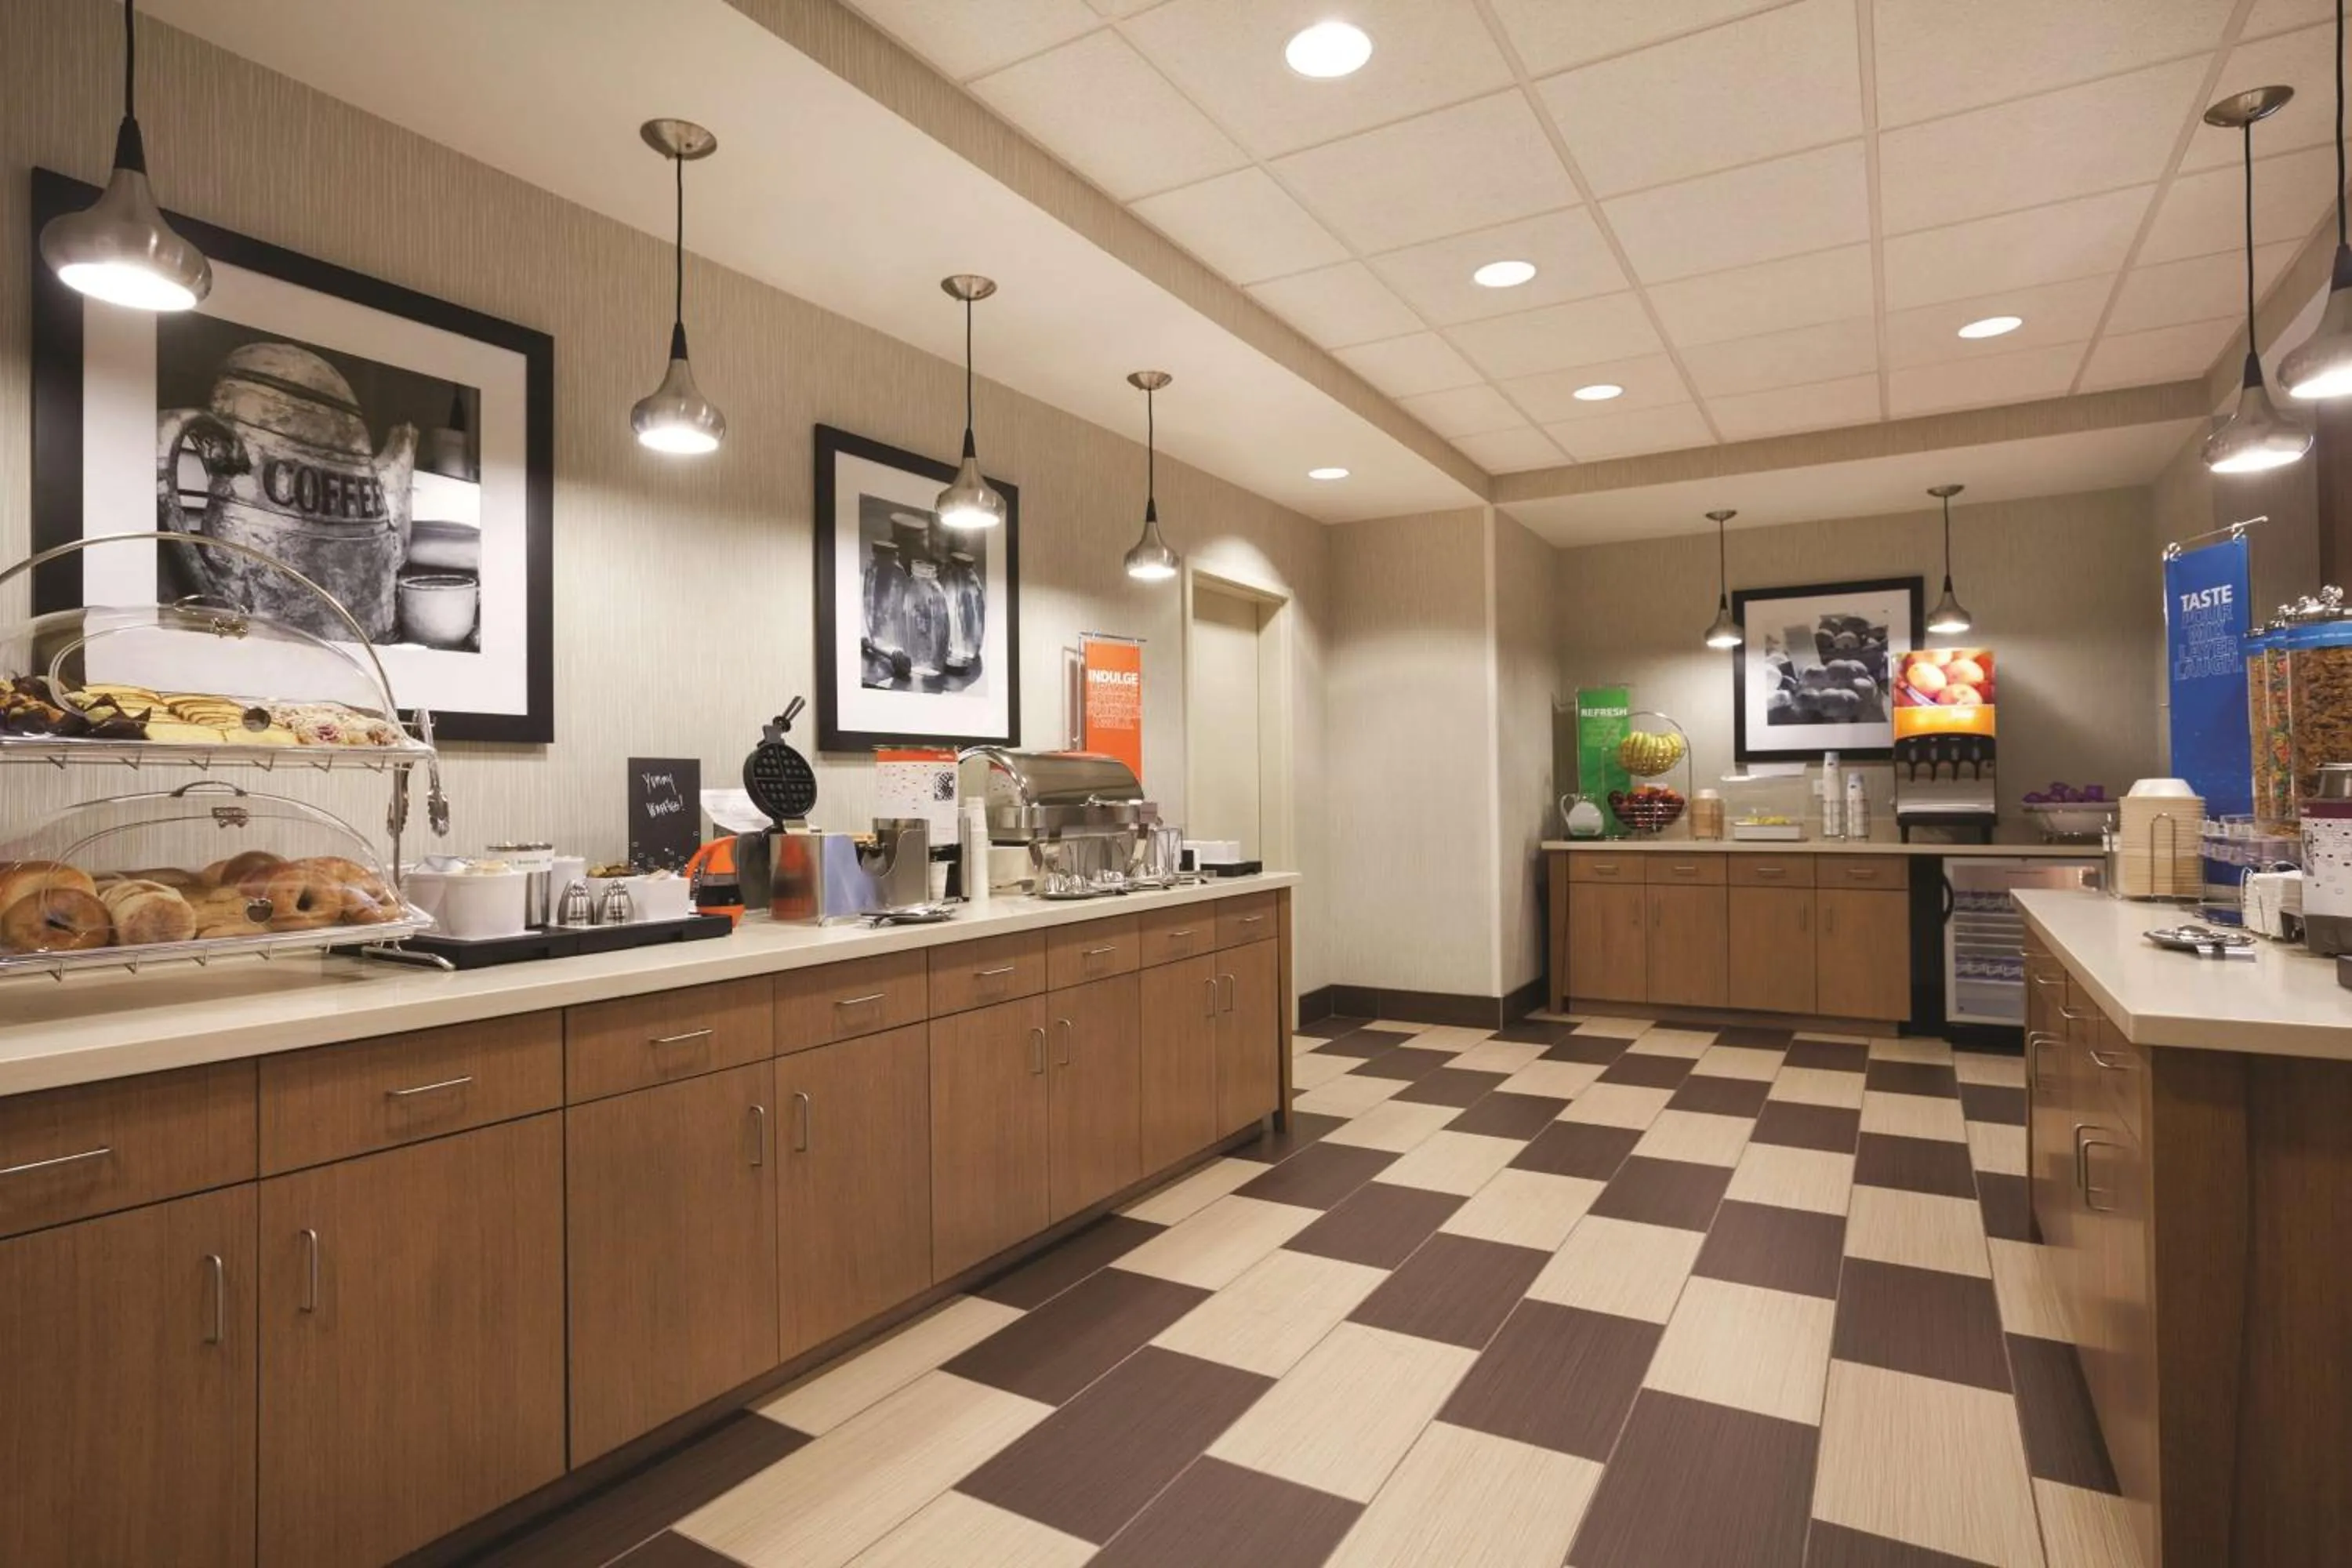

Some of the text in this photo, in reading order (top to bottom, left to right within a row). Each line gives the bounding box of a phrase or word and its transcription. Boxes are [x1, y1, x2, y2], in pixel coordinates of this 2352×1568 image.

[263, 458, 384, 517] COFFEE
[2180, 584, 2233, 612] TASTE
[1087, 670, 1138, 685] INDULGE
[1581, 707, 1627, 717] REFRESH
